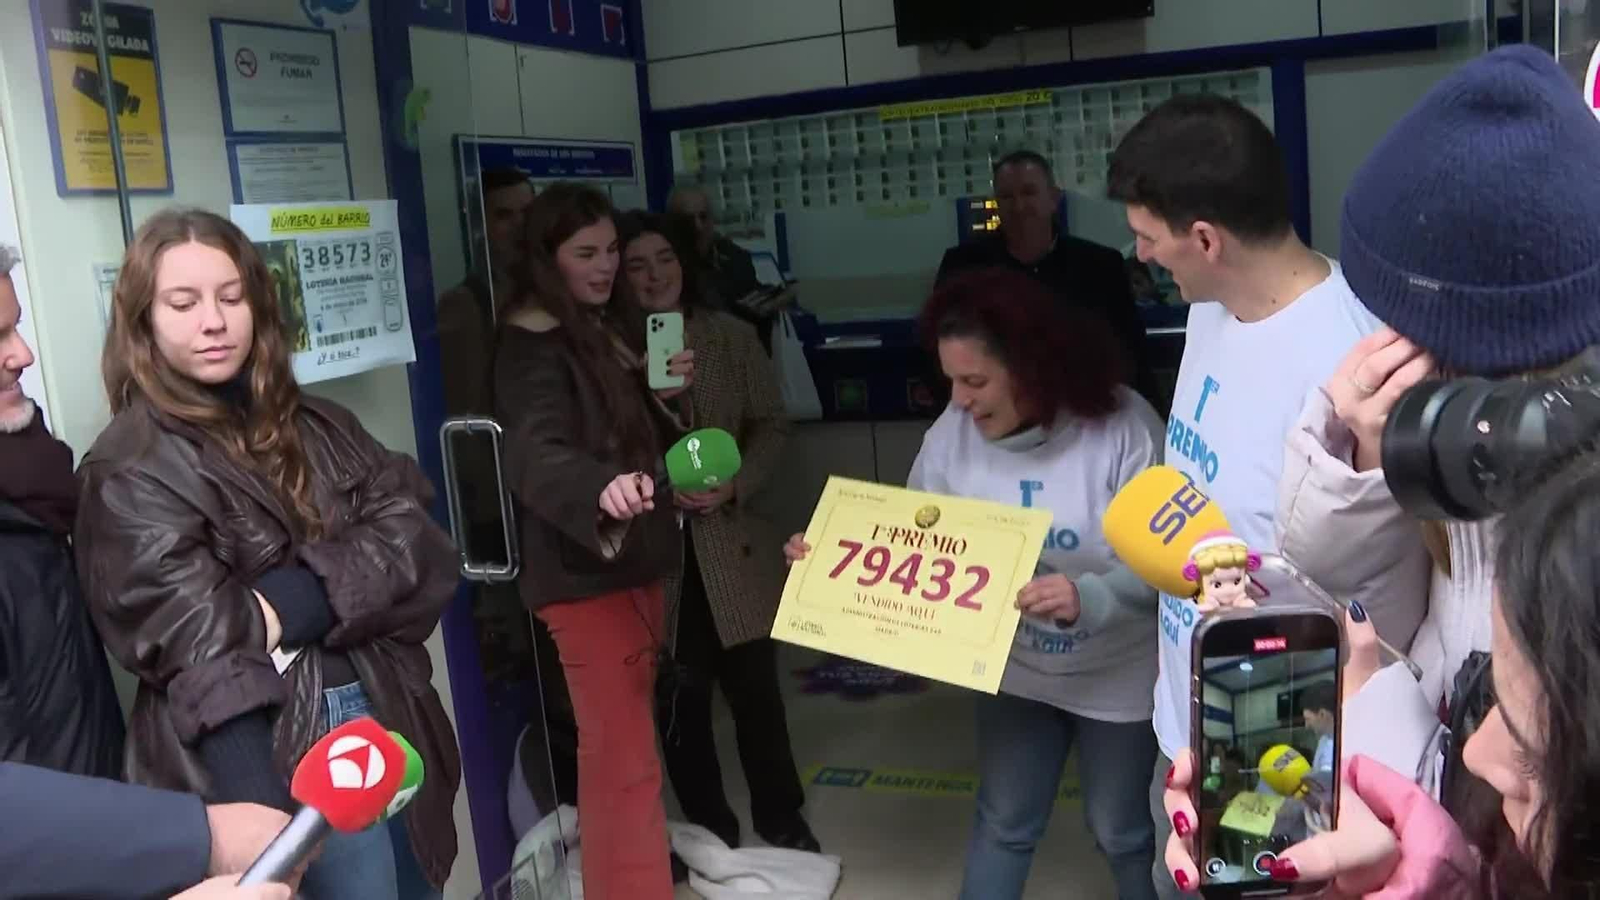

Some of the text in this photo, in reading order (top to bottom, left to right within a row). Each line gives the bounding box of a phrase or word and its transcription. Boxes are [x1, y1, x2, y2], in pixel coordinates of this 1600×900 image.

[50, 27, 149, 52] VIDEOVGILADA
[271, 211, 371, 229] NÚMERO del BARRIO
[302, 241, 372, 270] 38573
[828, 538, 990, 612] 79432
